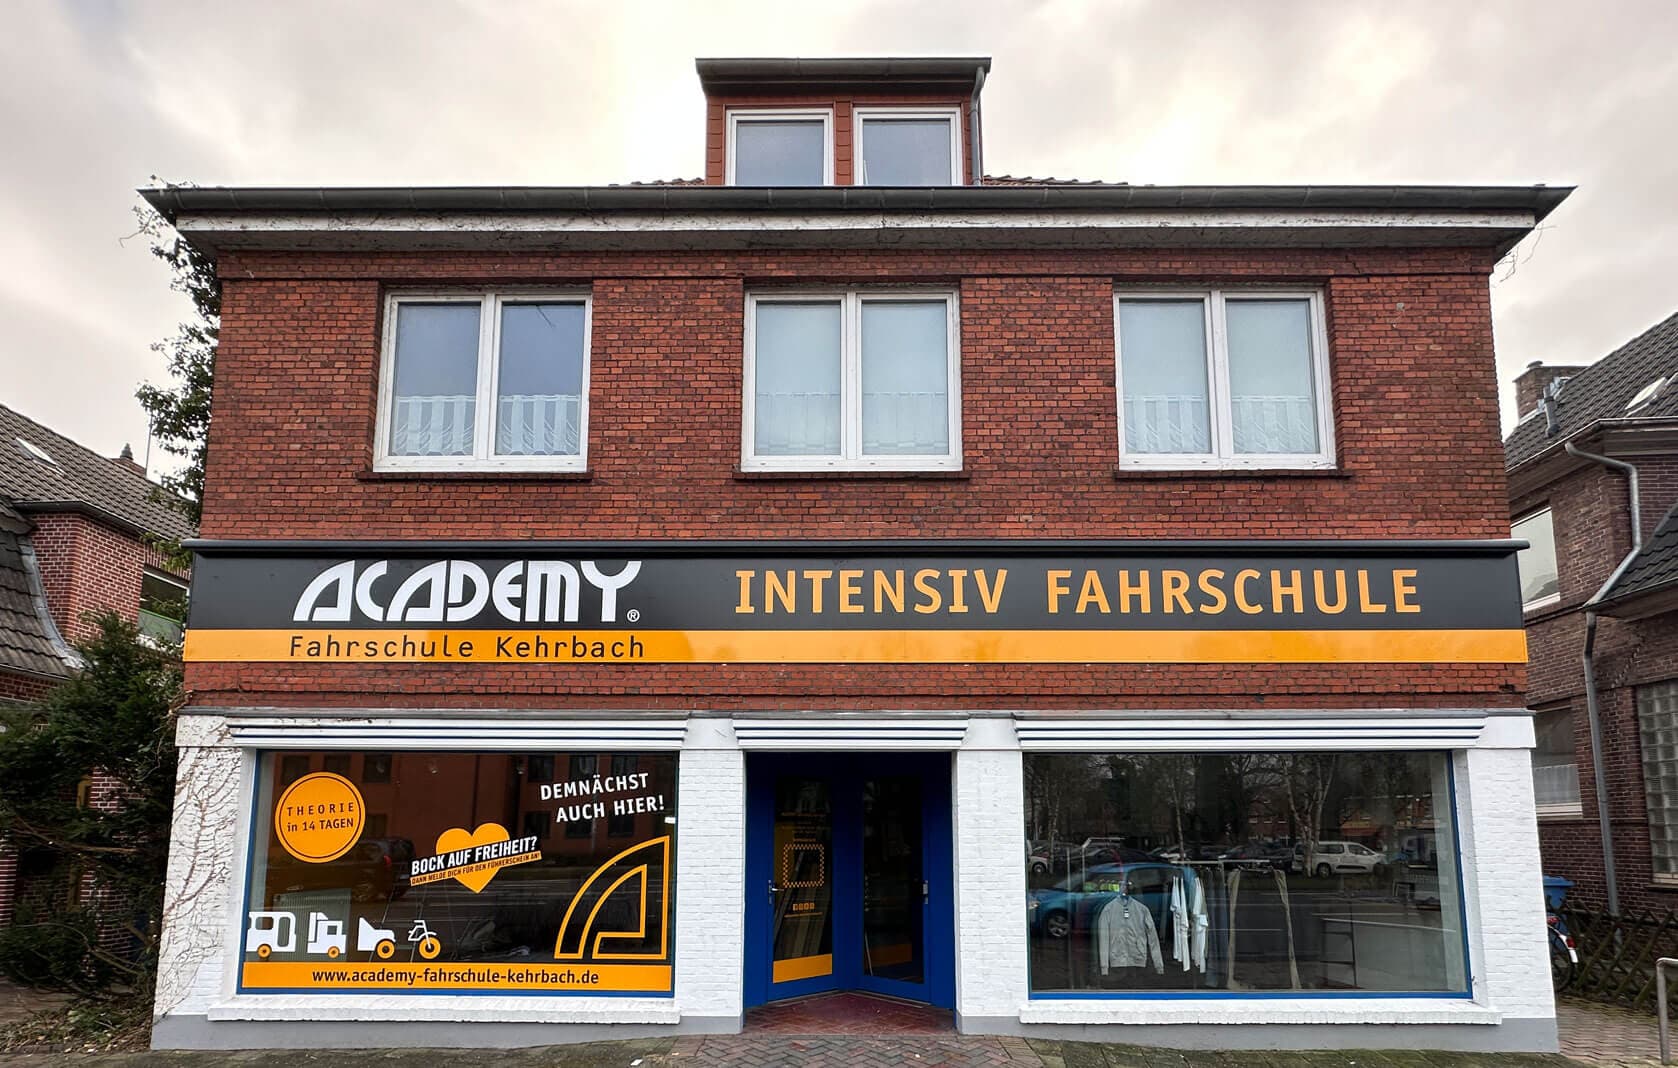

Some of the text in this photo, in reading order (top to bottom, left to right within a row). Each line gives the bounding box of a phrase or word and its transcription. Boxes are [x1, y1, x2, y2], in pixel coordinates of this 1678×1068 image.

[735, 568, 1422, 615] INTENSIV FAHRSCHULE
[290, 634, 644, 658] Fahrschule Kehrbach
[540, 772, 648, 801] DEMNÄCHST
[287, 802, 354, 817] THEORIE
[556, 795, 665, 823] AUCH HIER!
[287, 818, 354, 832] in 14 TAGEN
[411, 835, 538, 876] BOCK AUF FREIHEIT?
[411, 876, 428, 885] DANN
[428, 871, 447, 881] MELDE
[447, 868, 461, 878] DICH
[462, 865, 474, 875] FÜR
[474, 863, 487, 872] DEN
[312, 967, 600, 986] www.academy-fahrschule-kehrbach.de
